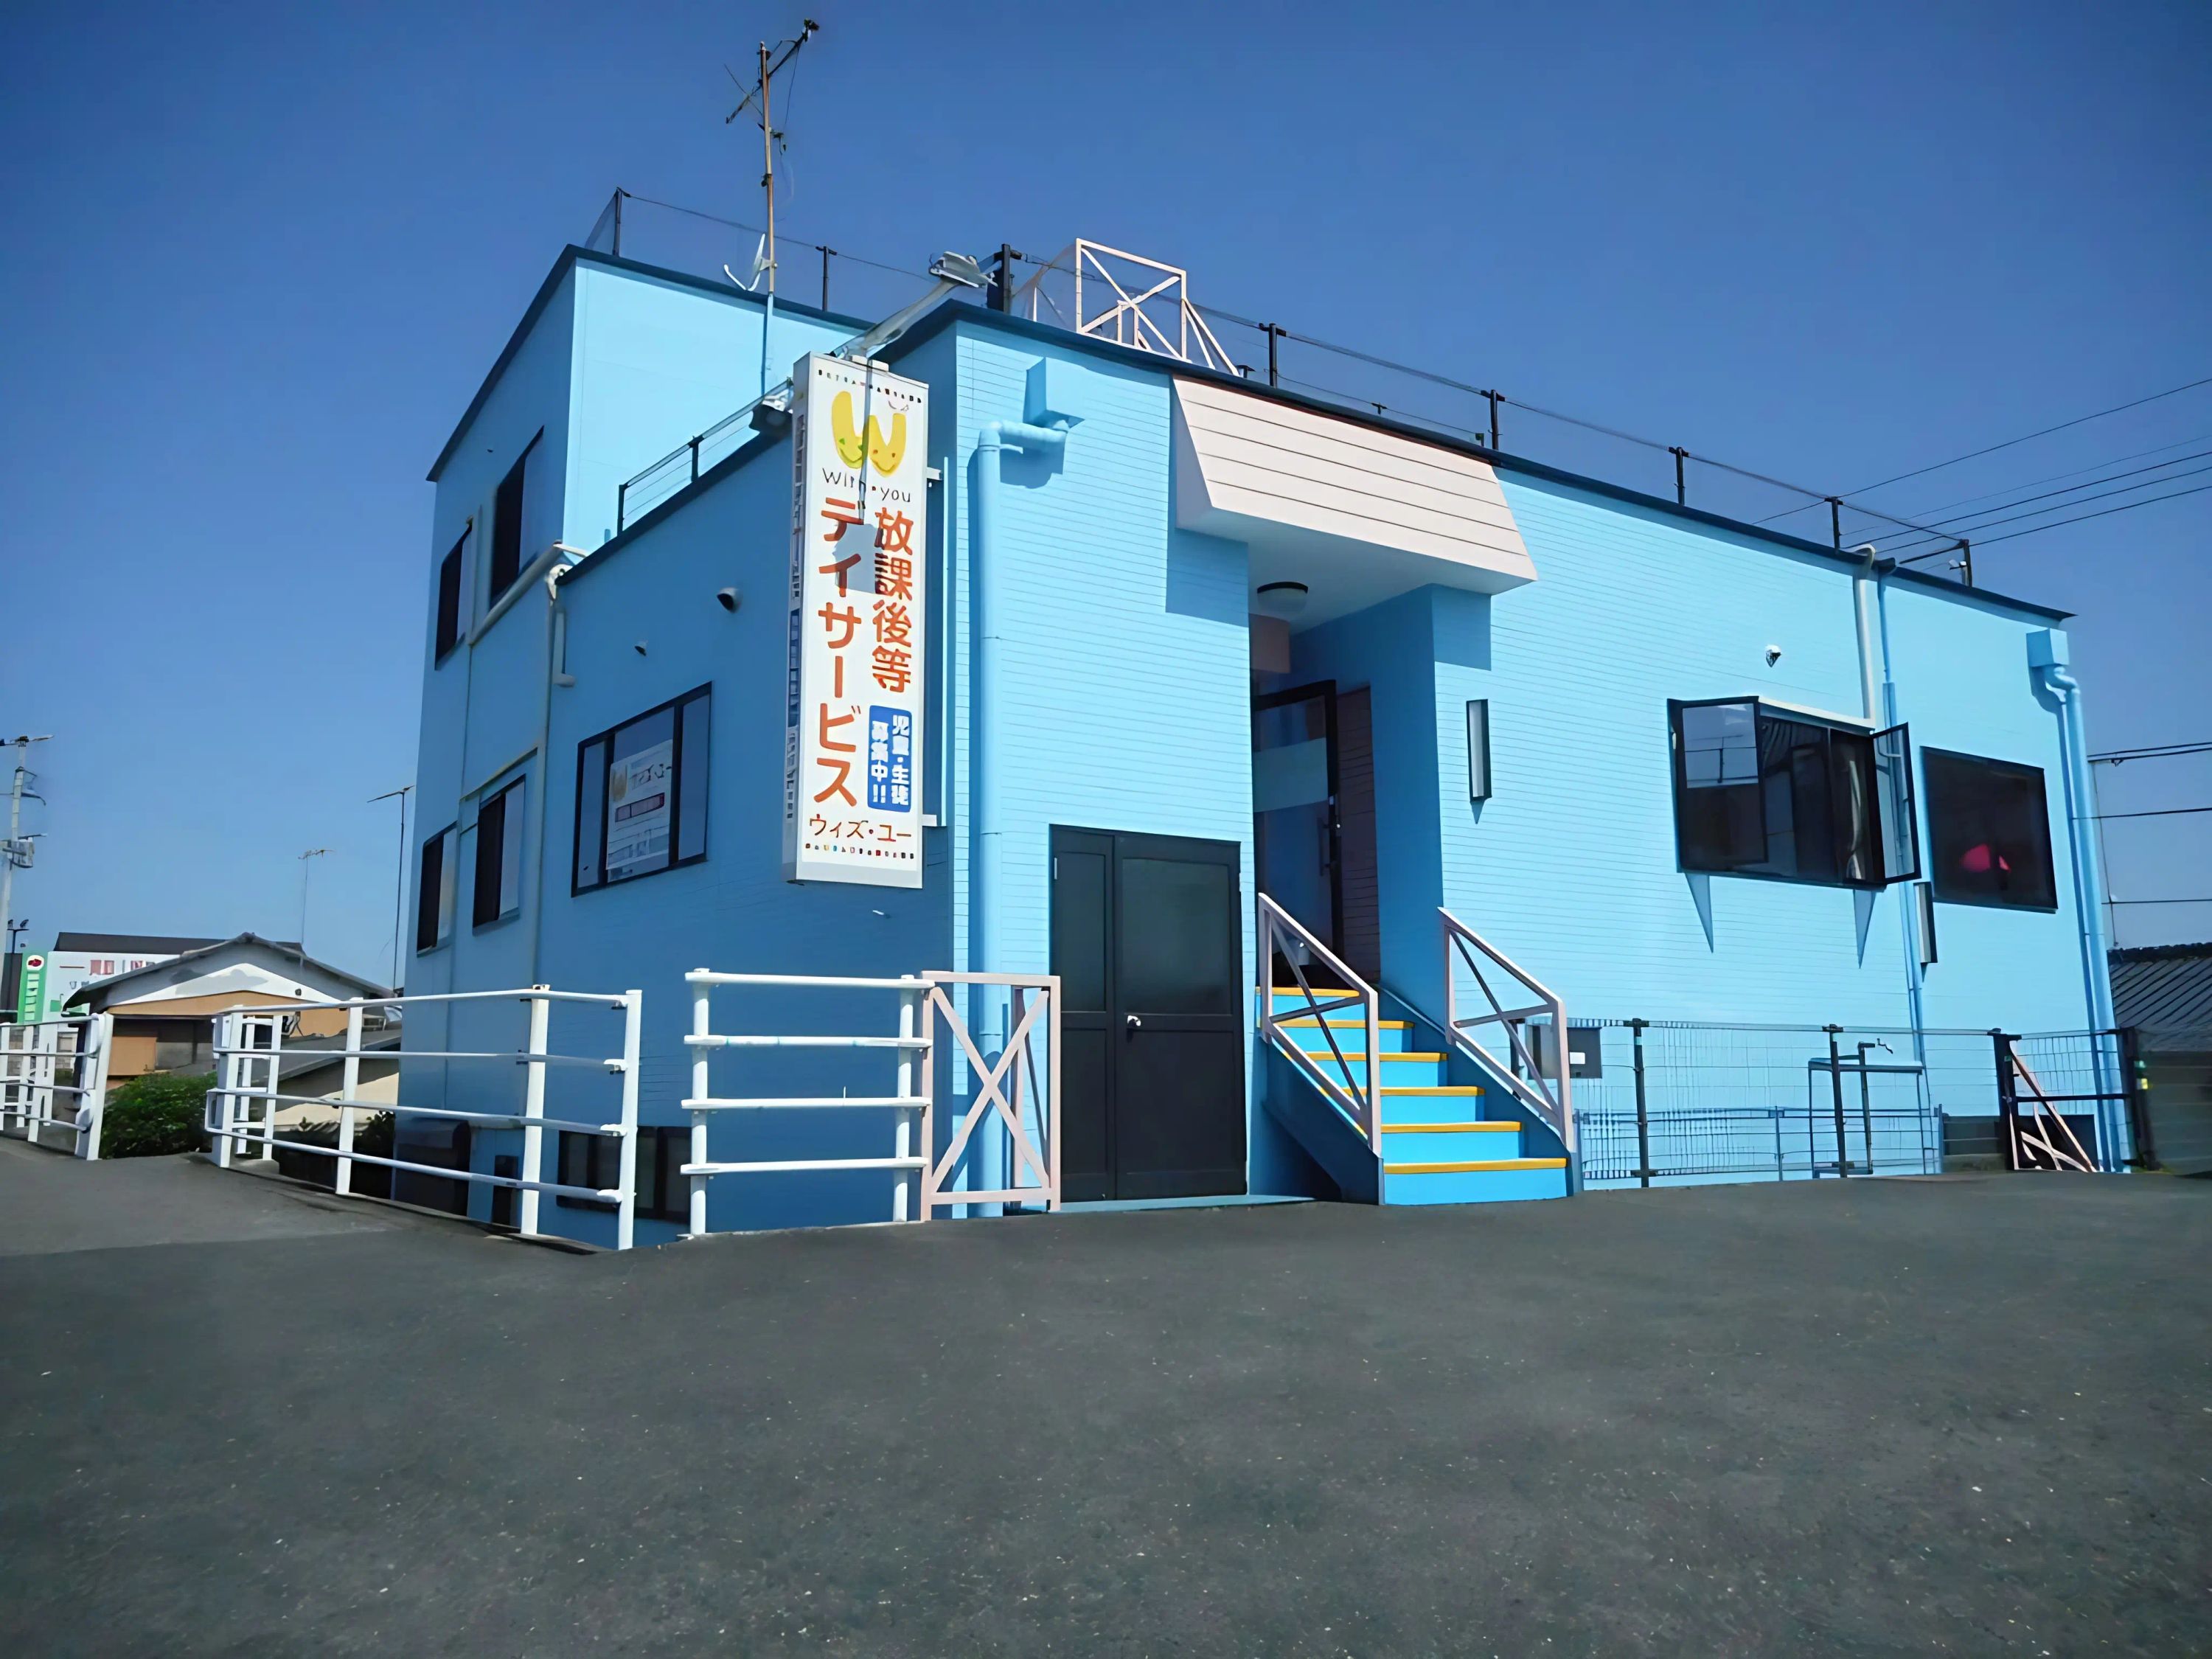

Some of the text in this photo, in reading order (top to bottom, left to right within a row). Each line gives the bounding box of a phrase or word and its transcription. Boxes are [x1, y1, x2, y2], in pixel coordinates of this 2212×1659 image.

[872, 507, 914, 692] 放課後等
[809, 813, 911, 842] ウィズ・ユー
